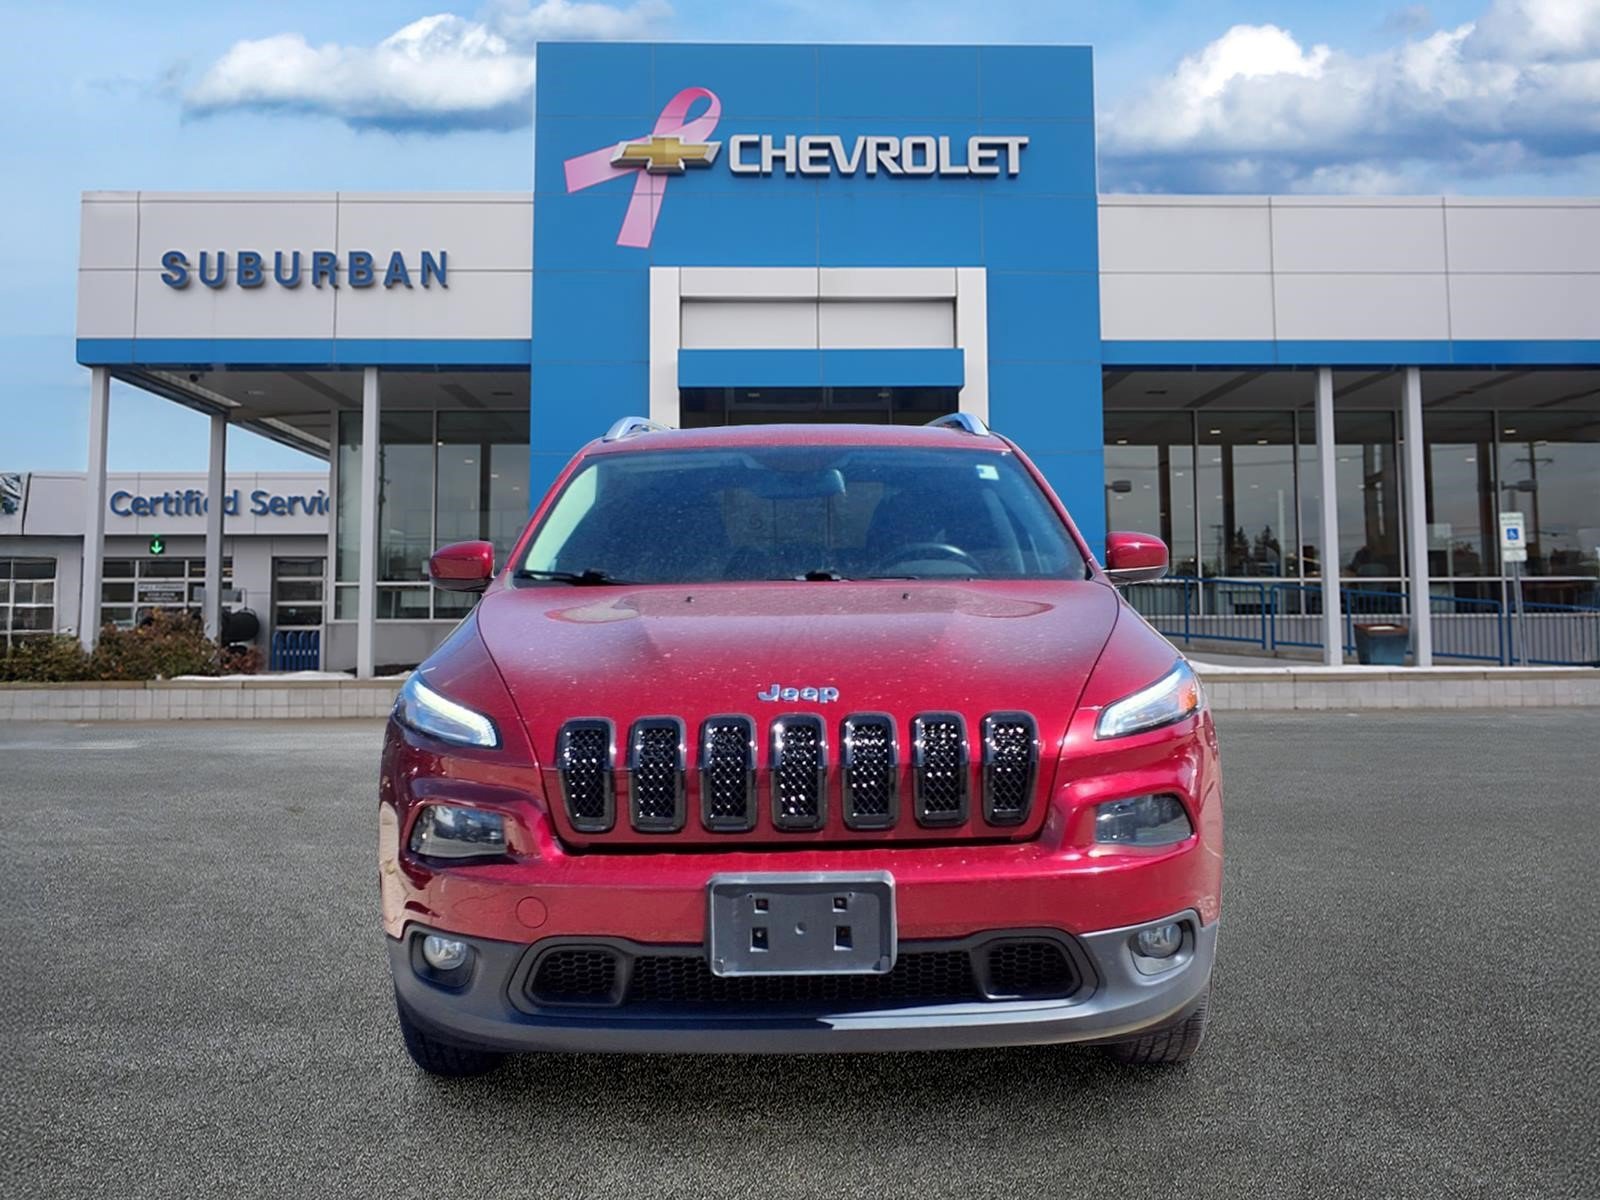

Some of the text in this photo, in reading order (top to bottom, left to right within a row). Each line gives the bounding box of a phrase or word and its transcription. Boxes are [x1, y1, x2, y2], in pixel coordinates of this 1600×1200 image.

[728, 134, 1029, 176] CHEVROLET
[161, 250, 449, 288] SUBURBAN
[110, 489, 240, 516] Certifid
[758, 683, 840, 704] Jeep
